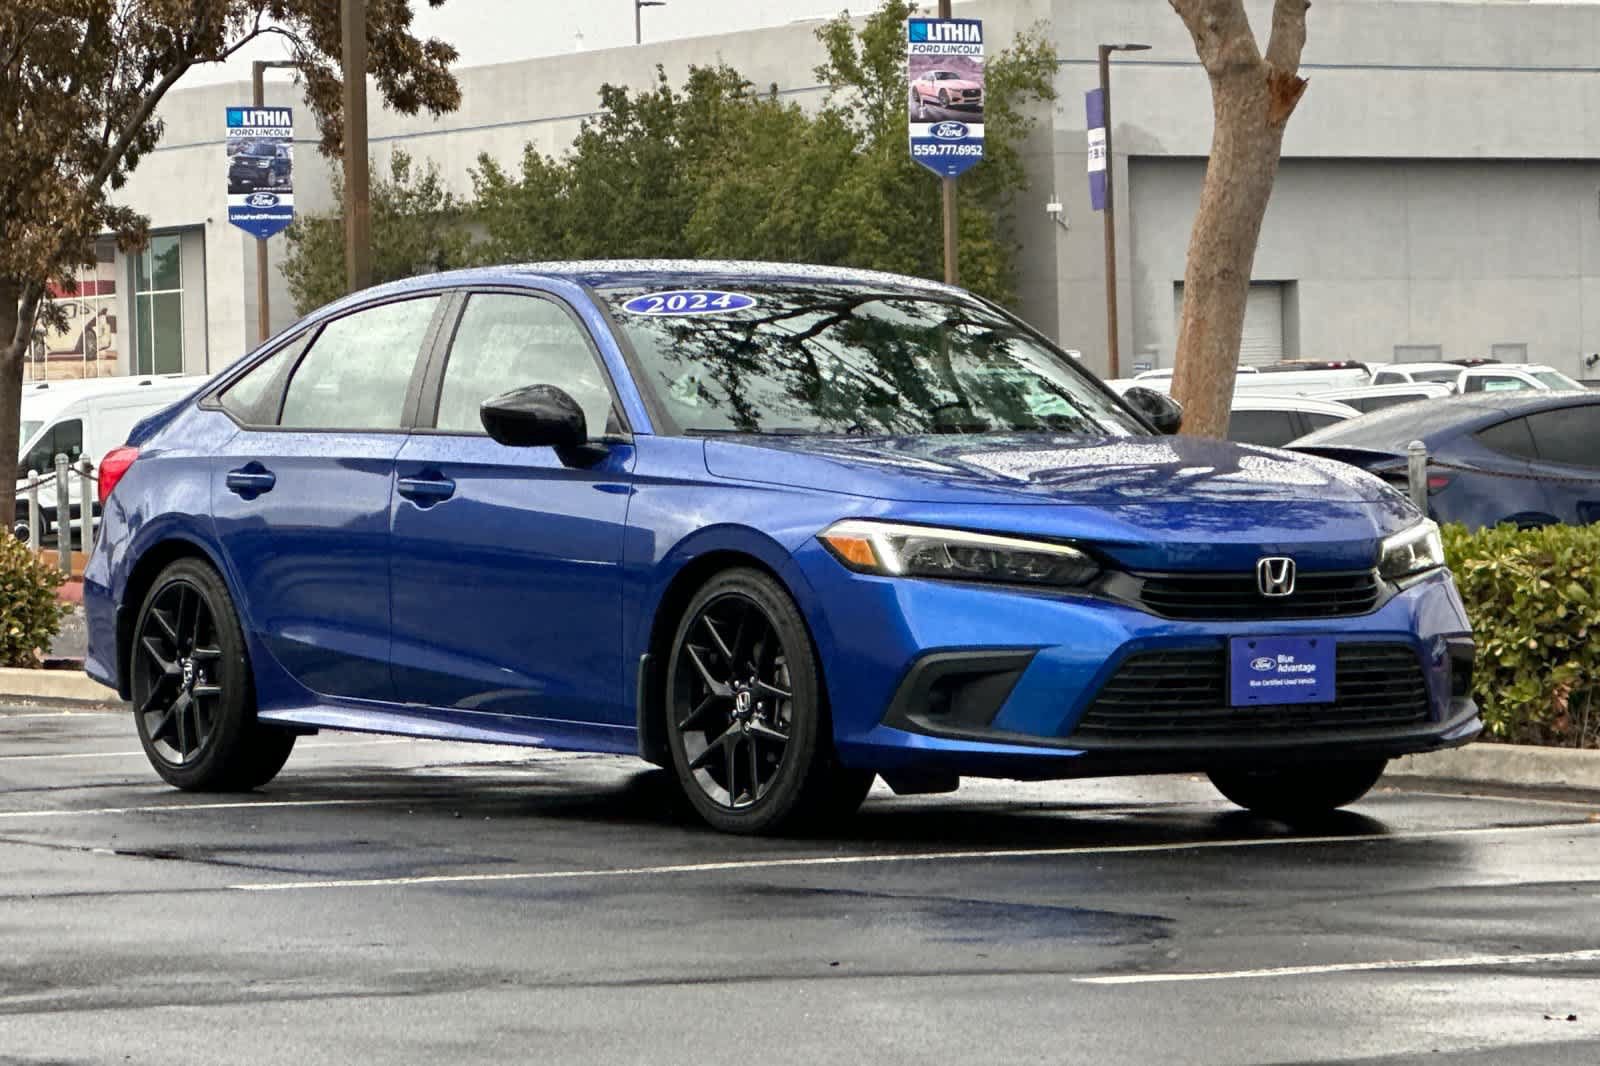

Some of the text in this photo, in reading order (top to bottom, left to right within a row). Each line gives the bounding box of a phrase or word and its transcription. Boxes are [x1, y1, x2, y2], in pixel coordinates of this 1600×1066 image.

[927, 23, 981, 42] LITHIA
[912, 45, 981, 54] FORD LINCOLN
[242, 110, 291, 126] LITHIA
[937, 124, 963, 137] Ford
[914, 144, 983, 156] 559.777.6952
[251, 194, 274, 206] Ford
[645, 294, 731, 313] 2024
[1277, 654, 1295, 663] Blue
[1277, 663, 1317, 673] Advantage
